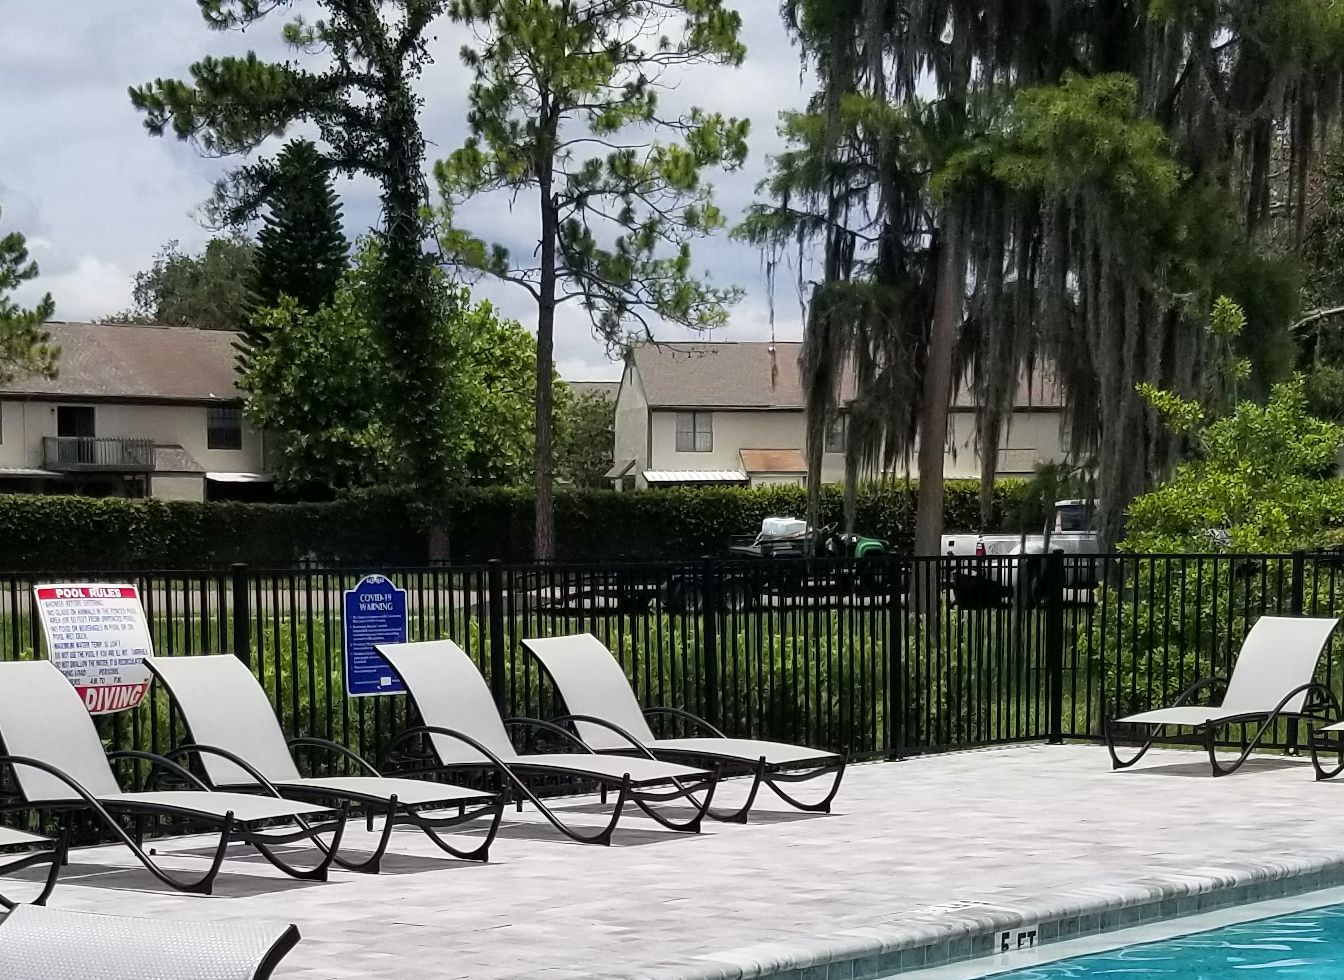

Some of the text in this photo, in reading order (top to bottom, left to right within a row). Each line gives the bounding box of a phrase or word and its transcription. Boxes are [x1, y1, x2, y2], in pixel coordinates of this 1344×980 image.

[56, 588, 122, 598] POOL RULES
[359, 593, 392, 602] COVID-19
[359, 603, 394, 611] WARNING
[85, 685, 143, 711] DIVING
[1017, 930, 1037, 951] FT
